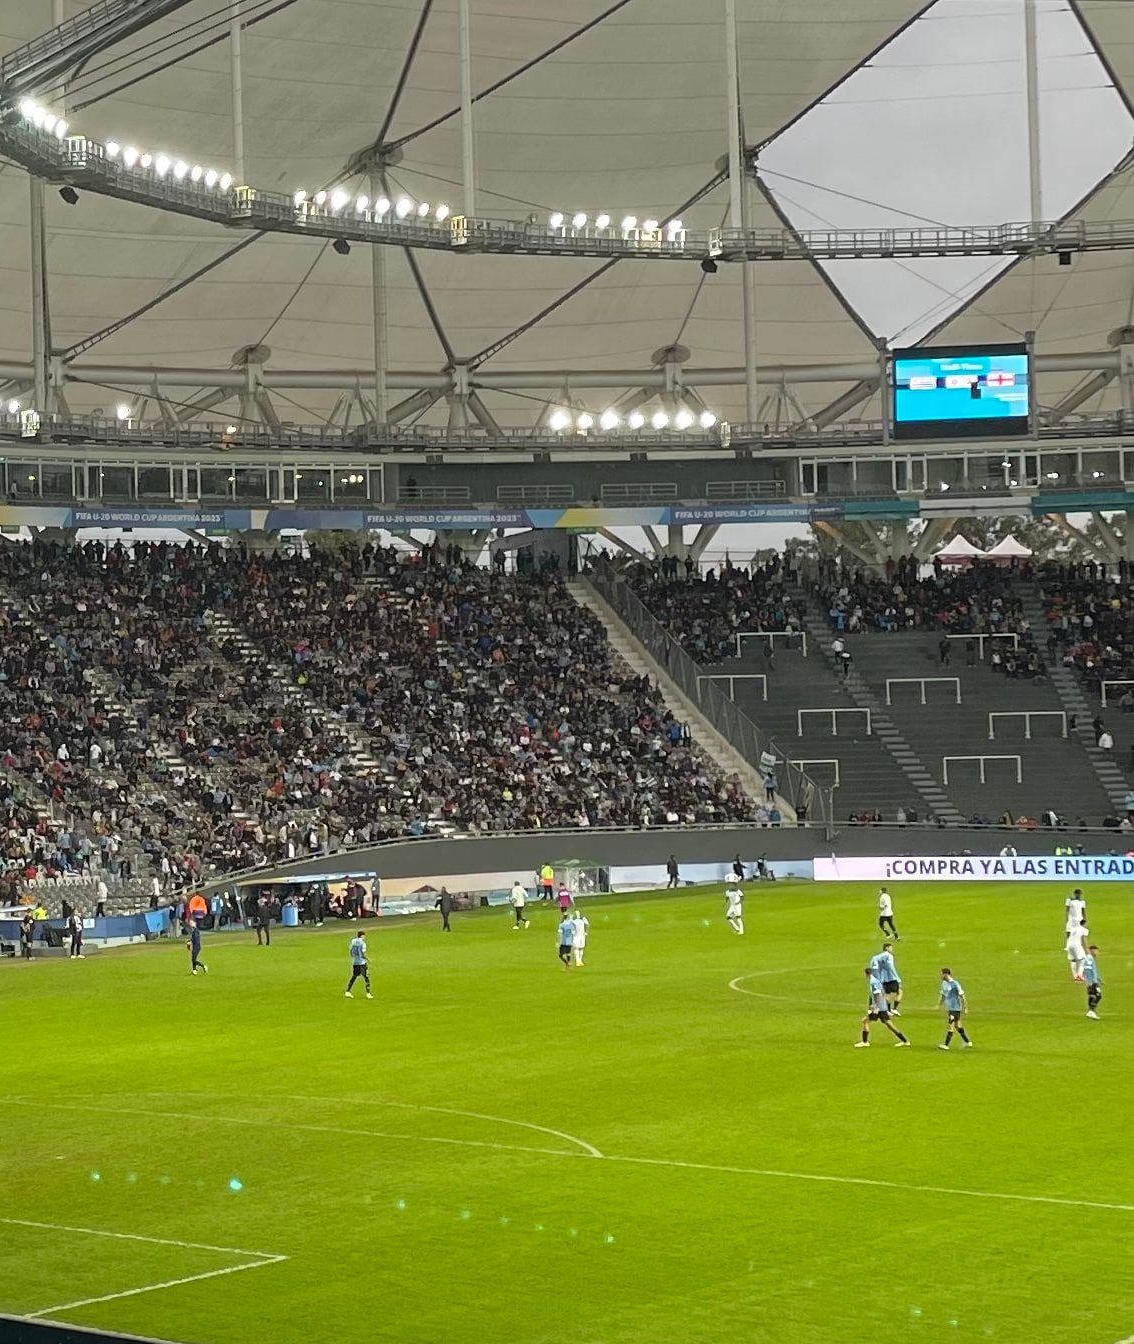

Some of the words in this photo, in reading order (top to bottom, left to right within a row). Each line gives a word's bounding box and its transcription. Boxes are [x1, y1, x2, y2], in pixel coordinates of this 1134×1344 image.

[75, 512, 92, 521] FIFA
[93, 512, 110, 521] U-20
[111, 513, 140, 522] WORLD
[141, 513, 157, 522] CUP
[367, 515, 384, 523] FIFA
[386, 515, 404, 523] U-20
[405, 515, 434, 523] WORLD
[435, 515, 452, 523] CUP
[674, 510, 693, 519] FIFA
[714, 510, 747, 518] WORLD
[748, 509, 765, 518] CUP
[885, 859, 975, 878] ¡COMPRA
[980, 859, 1006, 875] YA
[1012, 859, 1049, 875] LAS
